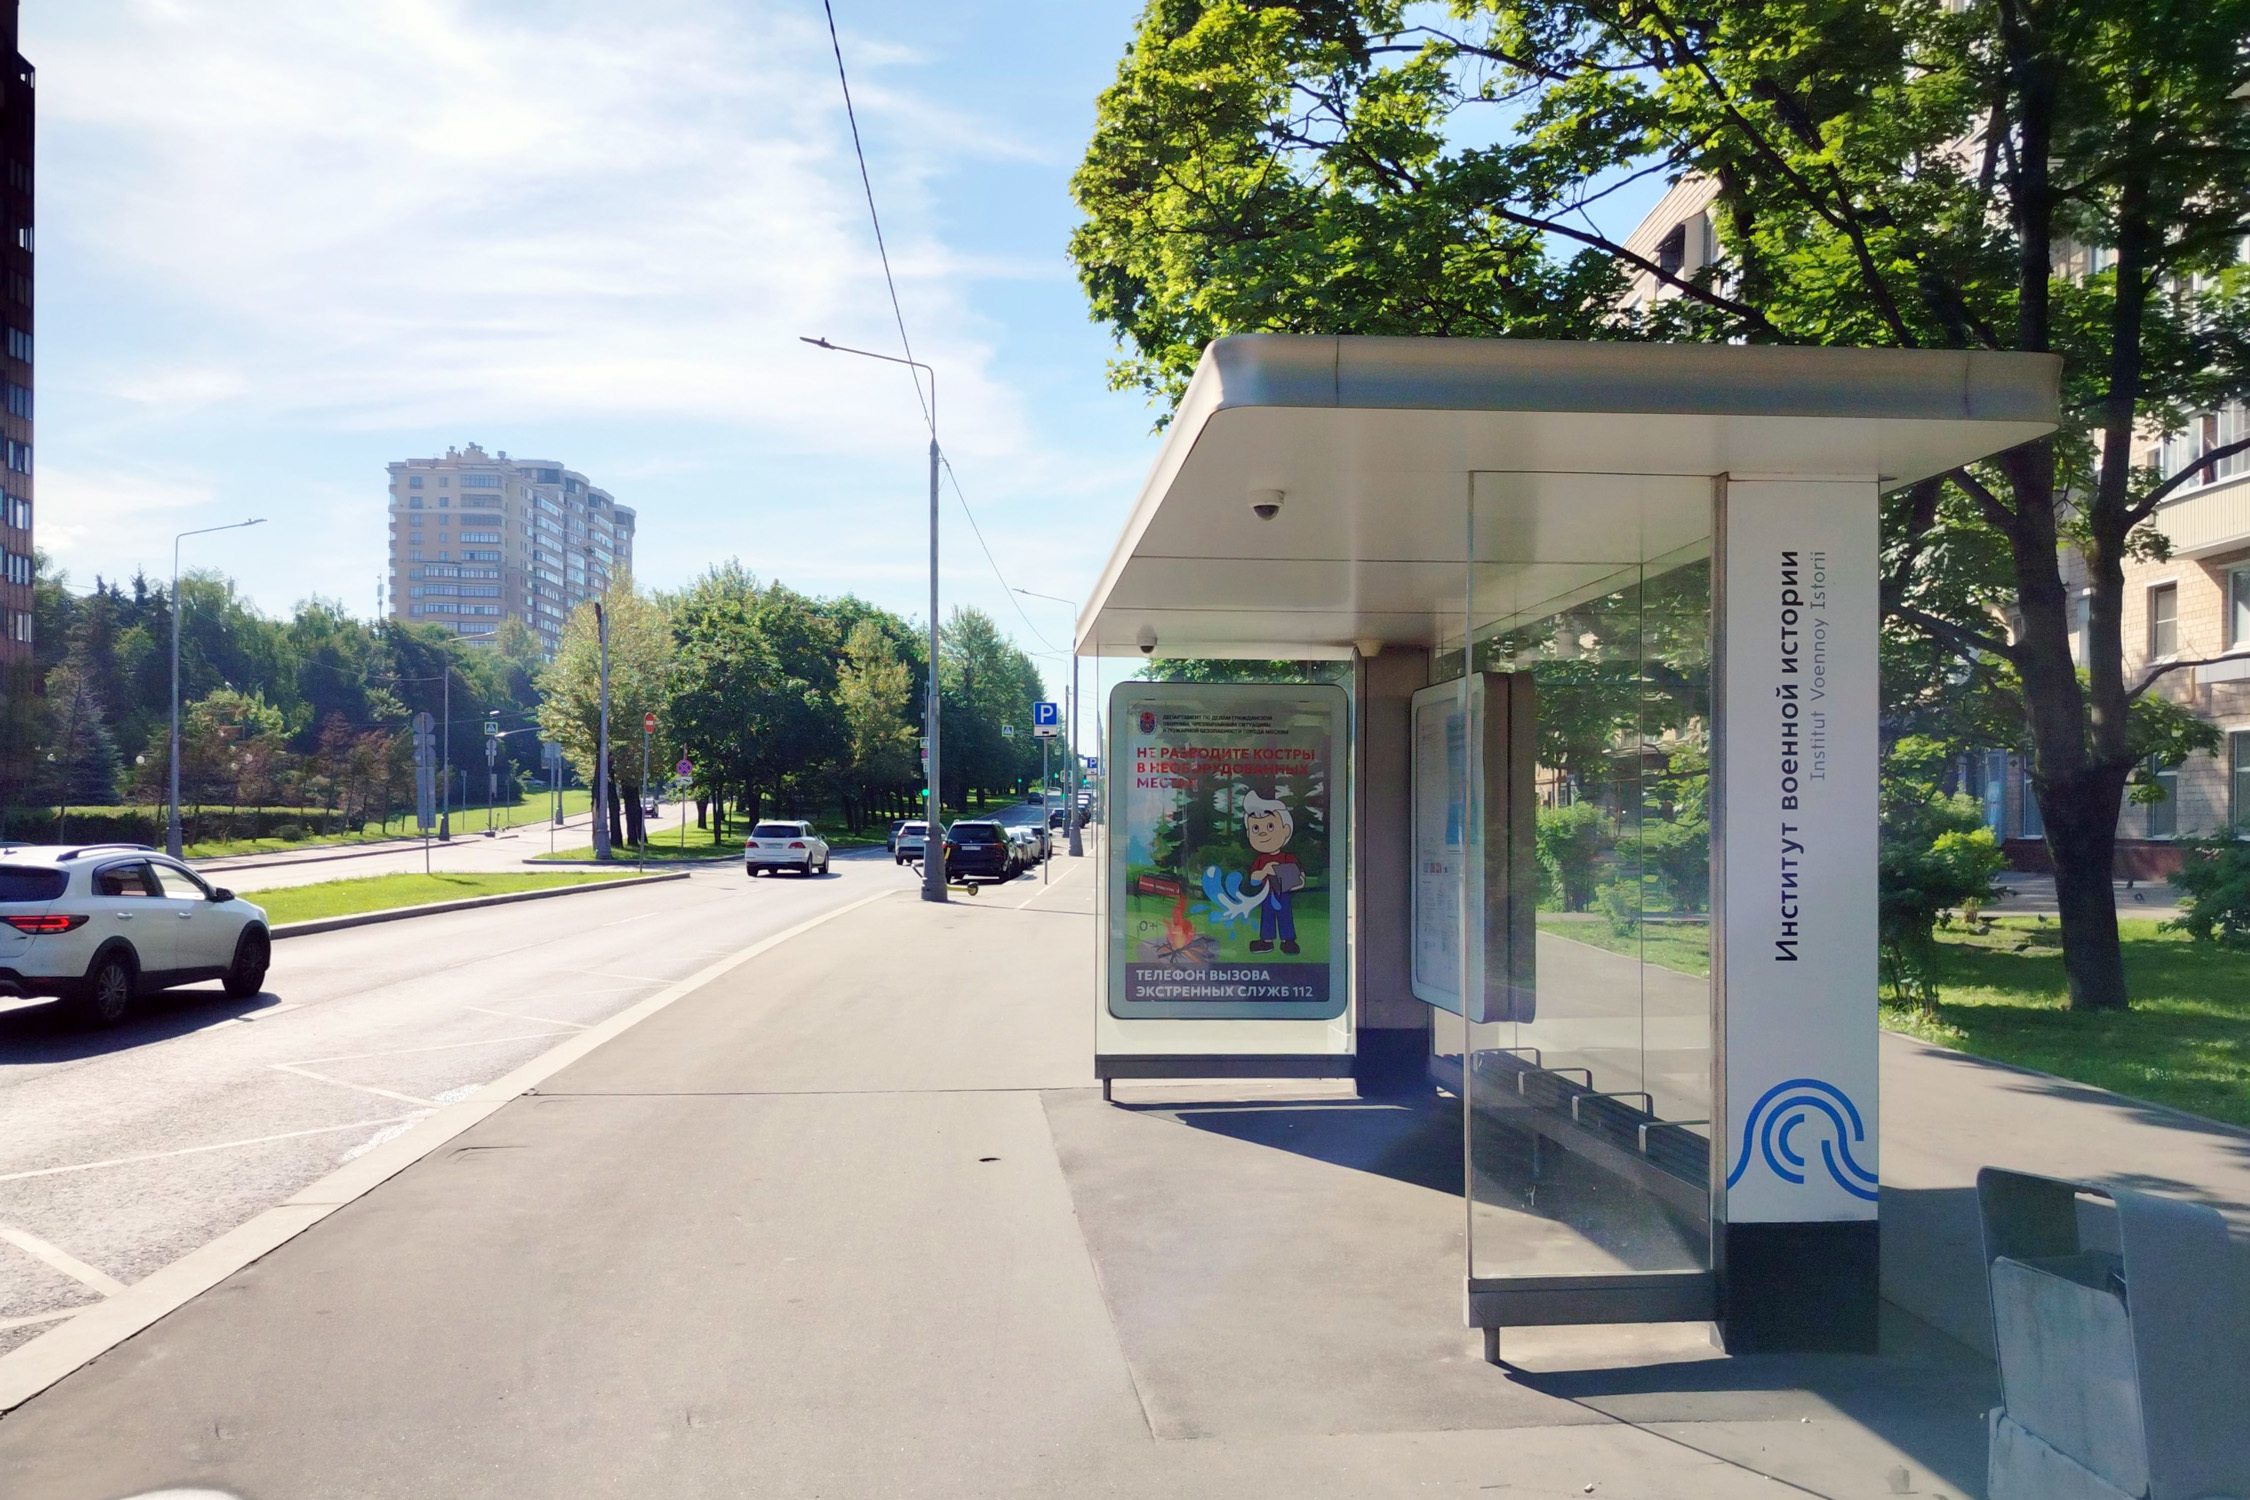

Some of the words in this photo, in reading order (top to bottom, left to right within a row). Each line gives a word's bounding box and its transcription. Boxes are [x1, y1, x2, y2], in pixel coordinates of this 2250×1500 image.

[1810, 551, 1825, 610] Istorii
[1781, 551, 1804, 673] истории
[1810, 618, 1829, 702] Voennoy
[1040, 704, 1054, 723] P
[1137, 747, 1156, 758] НЕ
[1160, 747, 1249, 761] РАЗВОДИТЕ
[1253, 747, 1315, 760] КОСТРЫ
[1775, 684, 1799, 810] военной
[1810, 711, 1825, 781] Institut
[1137, 762, 1146, 773] В
[1150, 762, 1309, 776] НЕОБОРУДОВАННЫХ
[1775, 822, 1804, 961] Институт
[1140, 920, 1157, 931] 0+
[1136, 969, 1205, 981] ТЕЛЕФОН
[1209, 969, 1270, 981] ВЫЗОВА
[1136, 986, 1234, 997] ЭКСТРЕННЫХ
[1237, 986, 1289, 997] СЛУЖБ
[1293, 986, 1313, 997] 112
